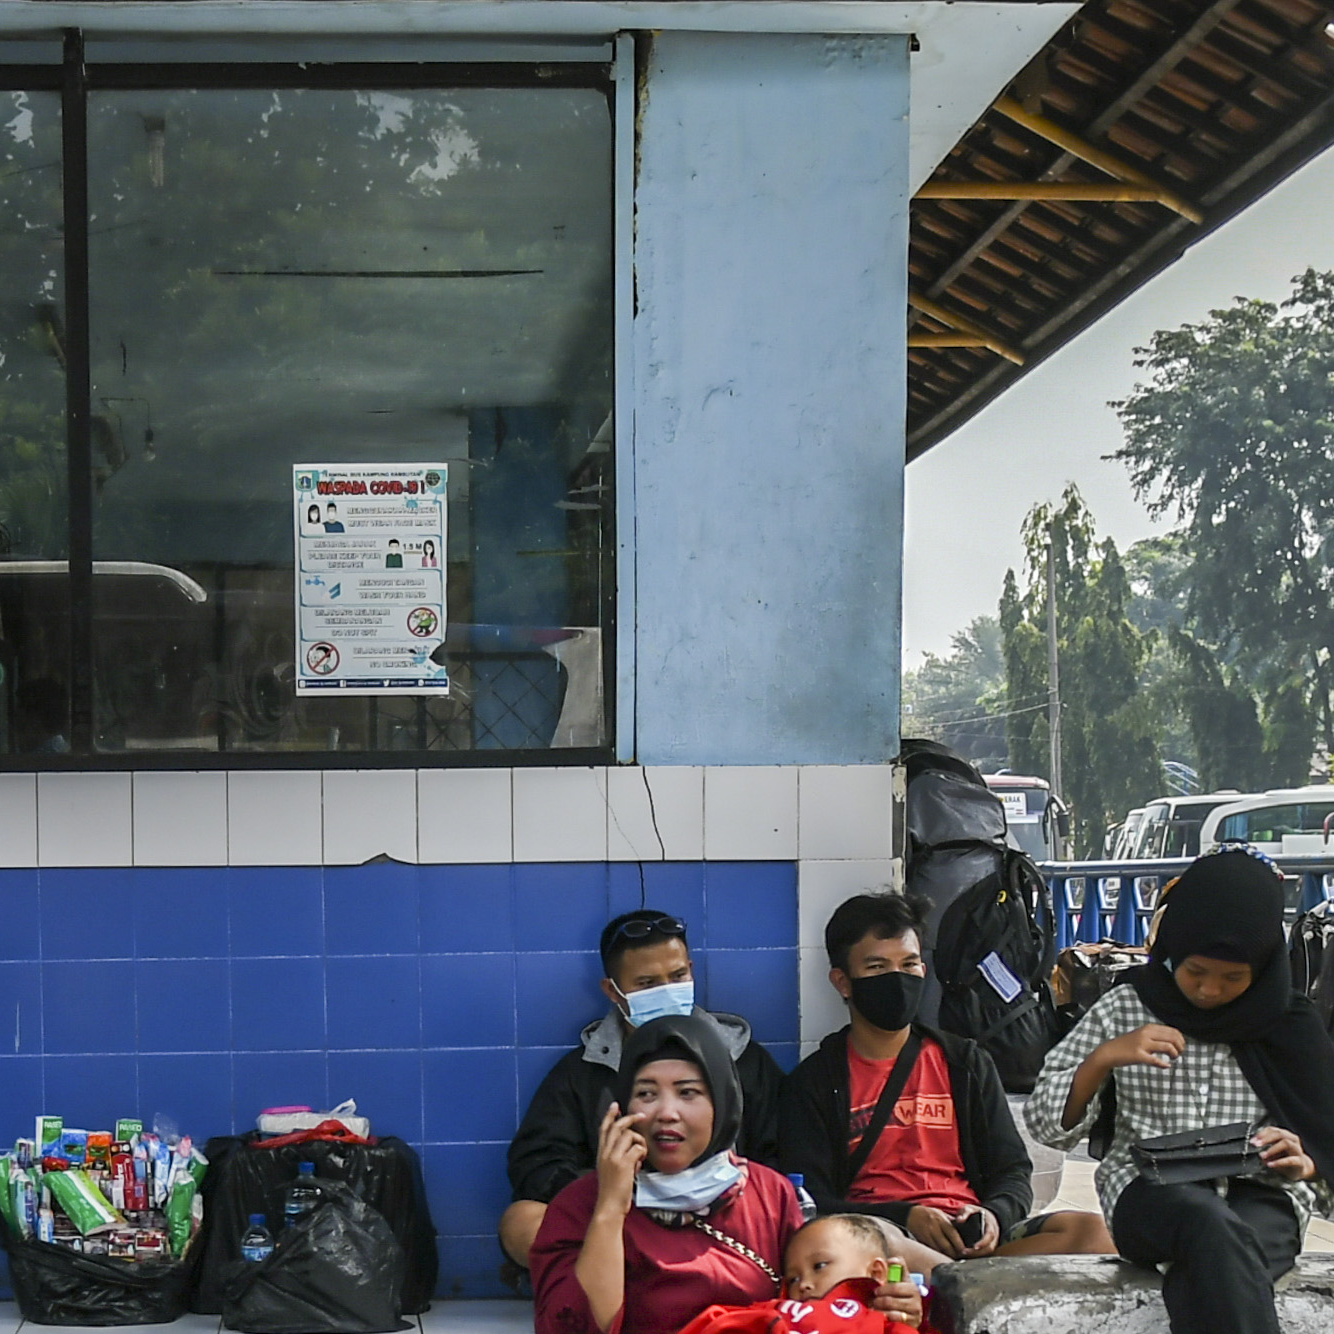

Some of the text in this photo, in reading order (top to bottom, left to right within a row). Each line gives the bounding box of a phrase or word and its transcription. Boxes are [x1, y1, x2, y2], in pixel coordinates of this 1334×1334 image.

[317, 481, 368, 495] WASPADA
[370, 481, 418, 495] COVID-19
[1003, 795, 1021, 804] ERAK
[899, 1103, 946, 1119] WEAR
